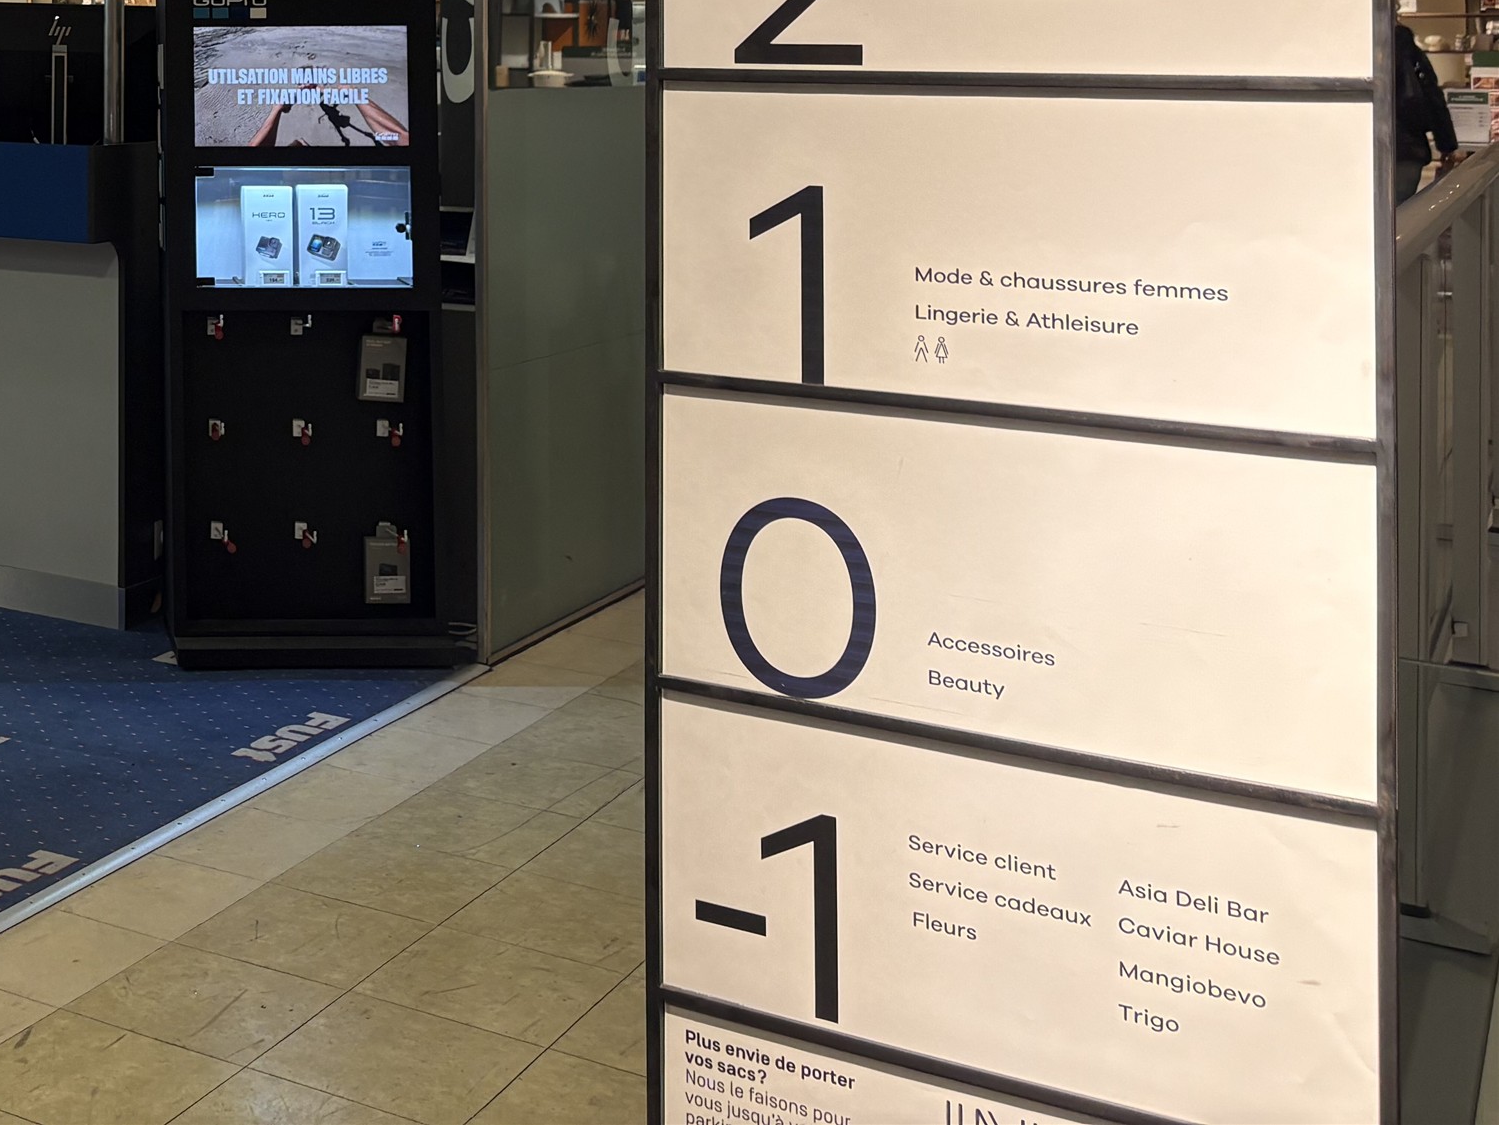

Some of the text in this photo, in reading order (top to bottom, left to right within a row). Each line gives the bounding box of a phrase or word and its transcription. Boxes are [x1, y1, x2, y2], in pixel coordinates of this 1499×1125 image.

[208, 67, 388, 85] UTILSATION MAINS LIBRES
[237, 88, 369, 105] ET FIXATION FACILE
[252, 211, 286, 219] HERO
[309, 207, 336, 221] 13
[748, 184, 825, 386] 1
[915, 266, 1229, 302] Mode & chaussures femmes
[915, 304, 1139, 336] Lingerie & Athleisure
[719, 496, 877, 700] 0
[927, 631, 1055, 667] Accessoires
[928, 669, 1005, 701] Beauty
[908, 834, 1057, 881] Service client
[908, 872, 1092, 928] Service cadeaux
[1118, 879, 1270, 924] Asia Deli Bar
[695, 814, 839, 1024] -1
[913, 911, 977, 941] Fleurs
[1118, 917, 1280, 966] Caviar House
[1119, 960, 1267, 1008] Mangiobevo
[1118, 1003, 1180, 1033] Trigo
[685, 1051, 767, 1084] vos sacs?
[686, 1029, 856, 1090] Plus envie de porter
[685, 1091, 722, 1113] vous
[686, 1069, 725, 1093] Nous
[730, 1081, 744, 1099] le
[749, 1087, 808, 1117] faisons
